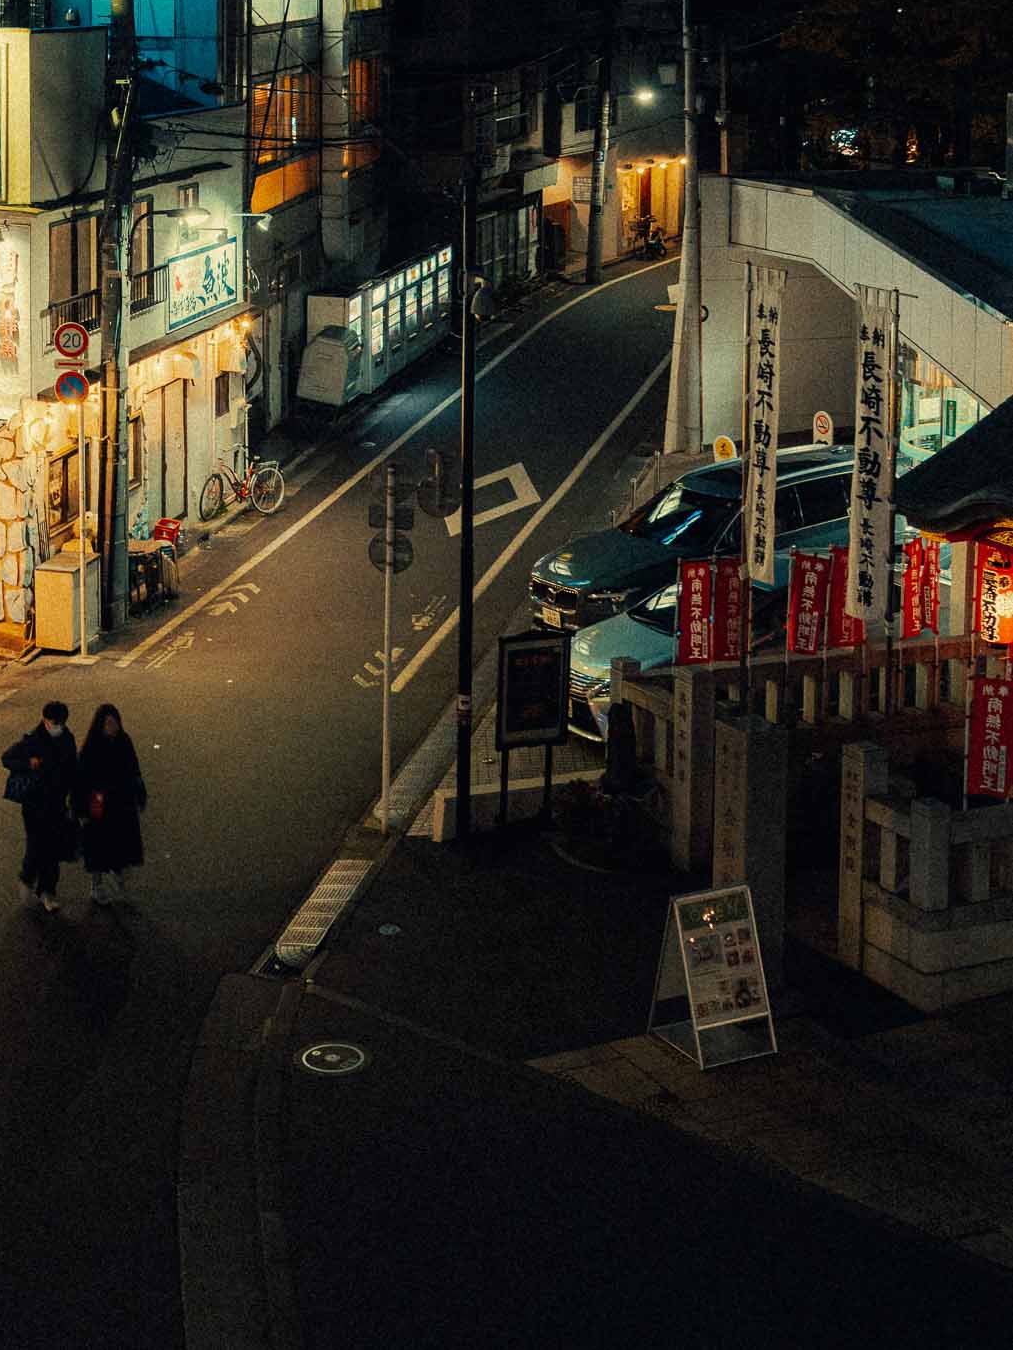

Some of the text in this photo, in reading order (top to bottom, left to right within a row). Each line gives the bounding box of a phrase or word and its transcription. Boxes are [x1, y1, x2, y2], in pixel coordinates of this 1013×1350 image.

[62, 332, 81, 349] 20
[753, 327, 776, 478] 長崎不動尊
[856, 351, 886, 509] 長崎不動尊
